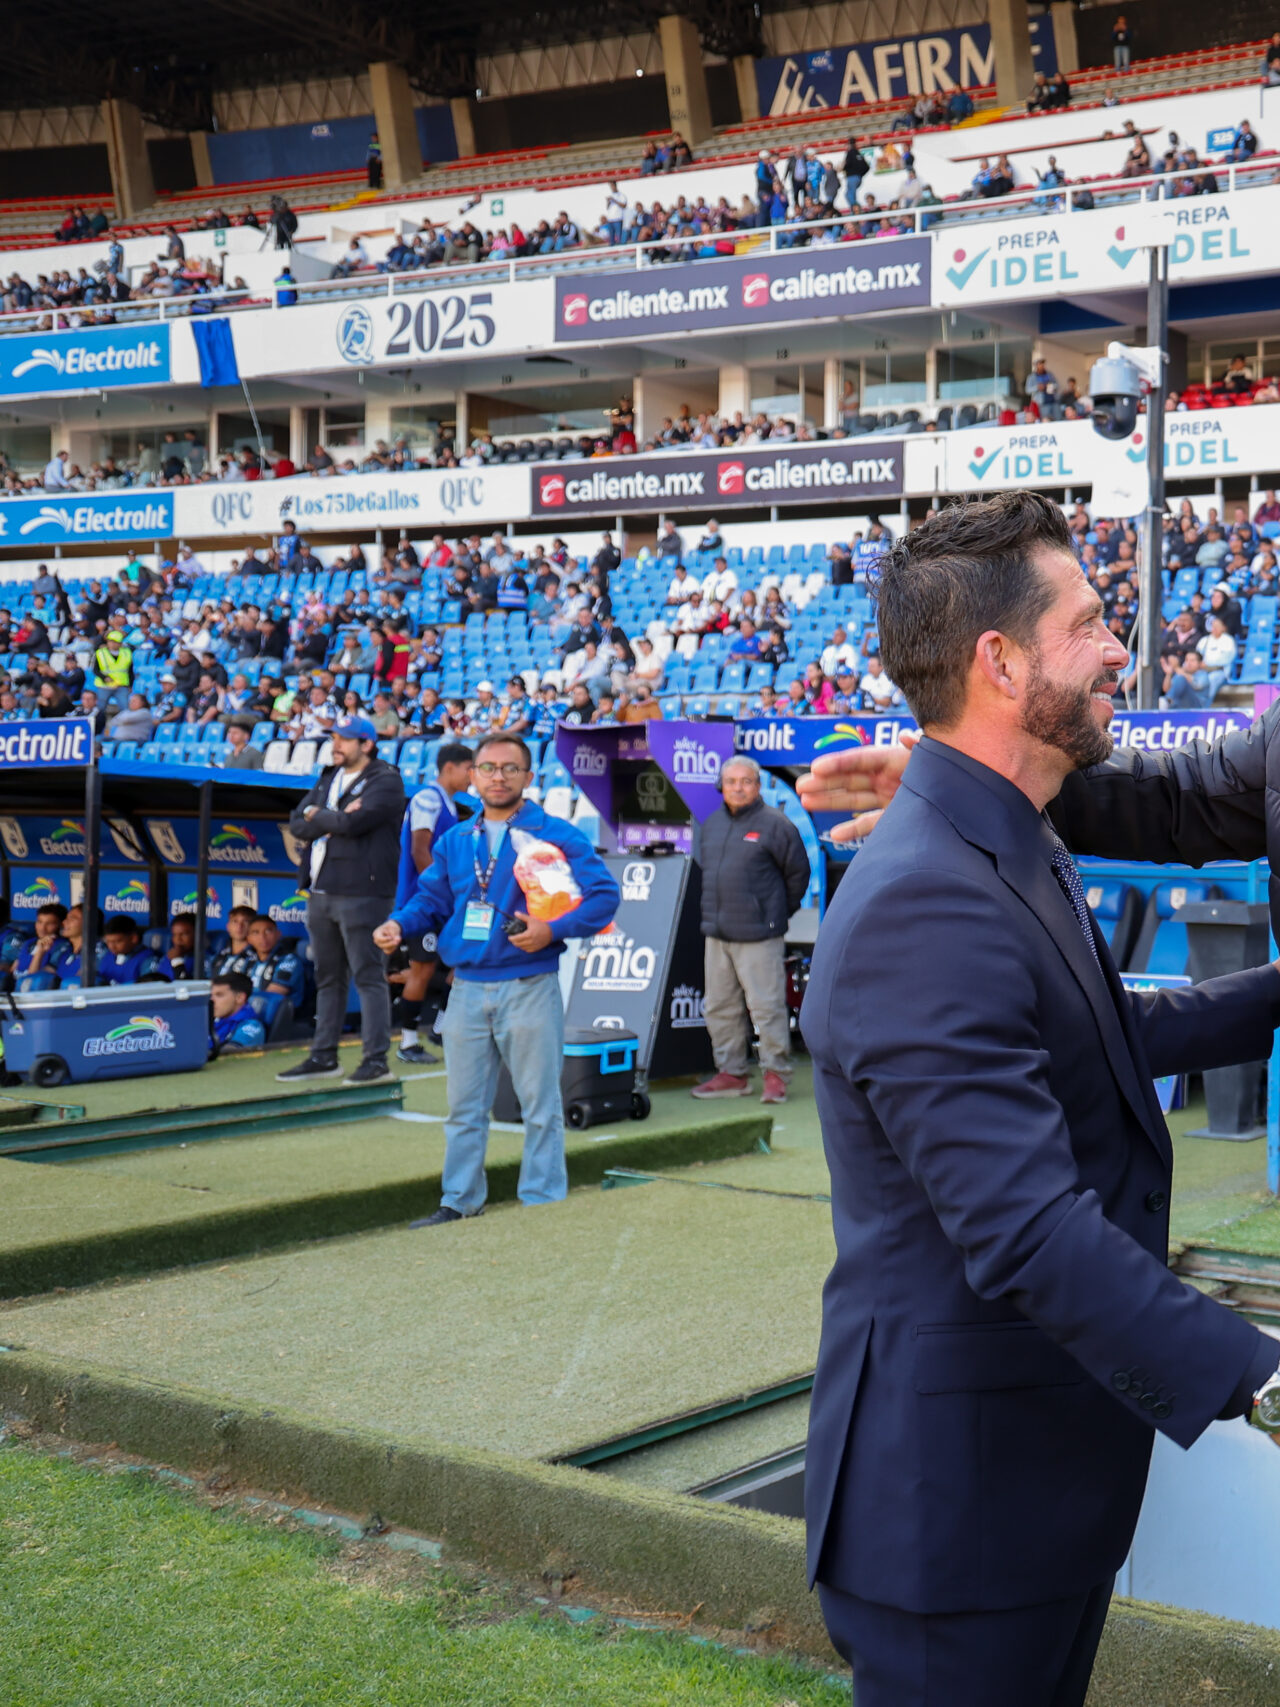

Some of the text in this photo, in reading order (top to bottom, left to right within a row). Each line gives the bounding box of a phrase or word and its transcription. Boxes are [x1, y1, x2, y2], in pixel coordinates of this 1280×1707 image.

[838, 22, 1041, 107] AFIRM
[1163, 206, 1230, 226] REPA
[998, 230, 1060, 250] PREPA
[1170, 227, 1250, 264] DEL
[770, 262, 921, 302] caliente.mx
[990, 251, 1079, 288] IDEL
[589, 285, 728, 321] caliente.mx
[386, 293, 496, 355] 2025
[64, 343, 162, 375] Electrolit
[1009, 433, 1058, 450] PREPA
[1170, 421, 1222, 437] PREPA
[745, 458, 895, 491] caliente.mx
[1004, 452, 1073, 479] IDEL
[440, 477, 483, 514] QFC
[565, 471, 704, 503] caliente.mx
[73, 504, 168, 533] Electrolit
[212, 490, 420, 526] QFC #Los75DeGallos
[735, 722, 796, 751] trolit
[207, 845, 268, 863] lectrolit
[105, 894, 149, 913] Electroli
[622, 885, 650, 900] VAR
[590, 933, 625, 947] JUMEX
[83, 1032, 176, 1058] Electrolit
